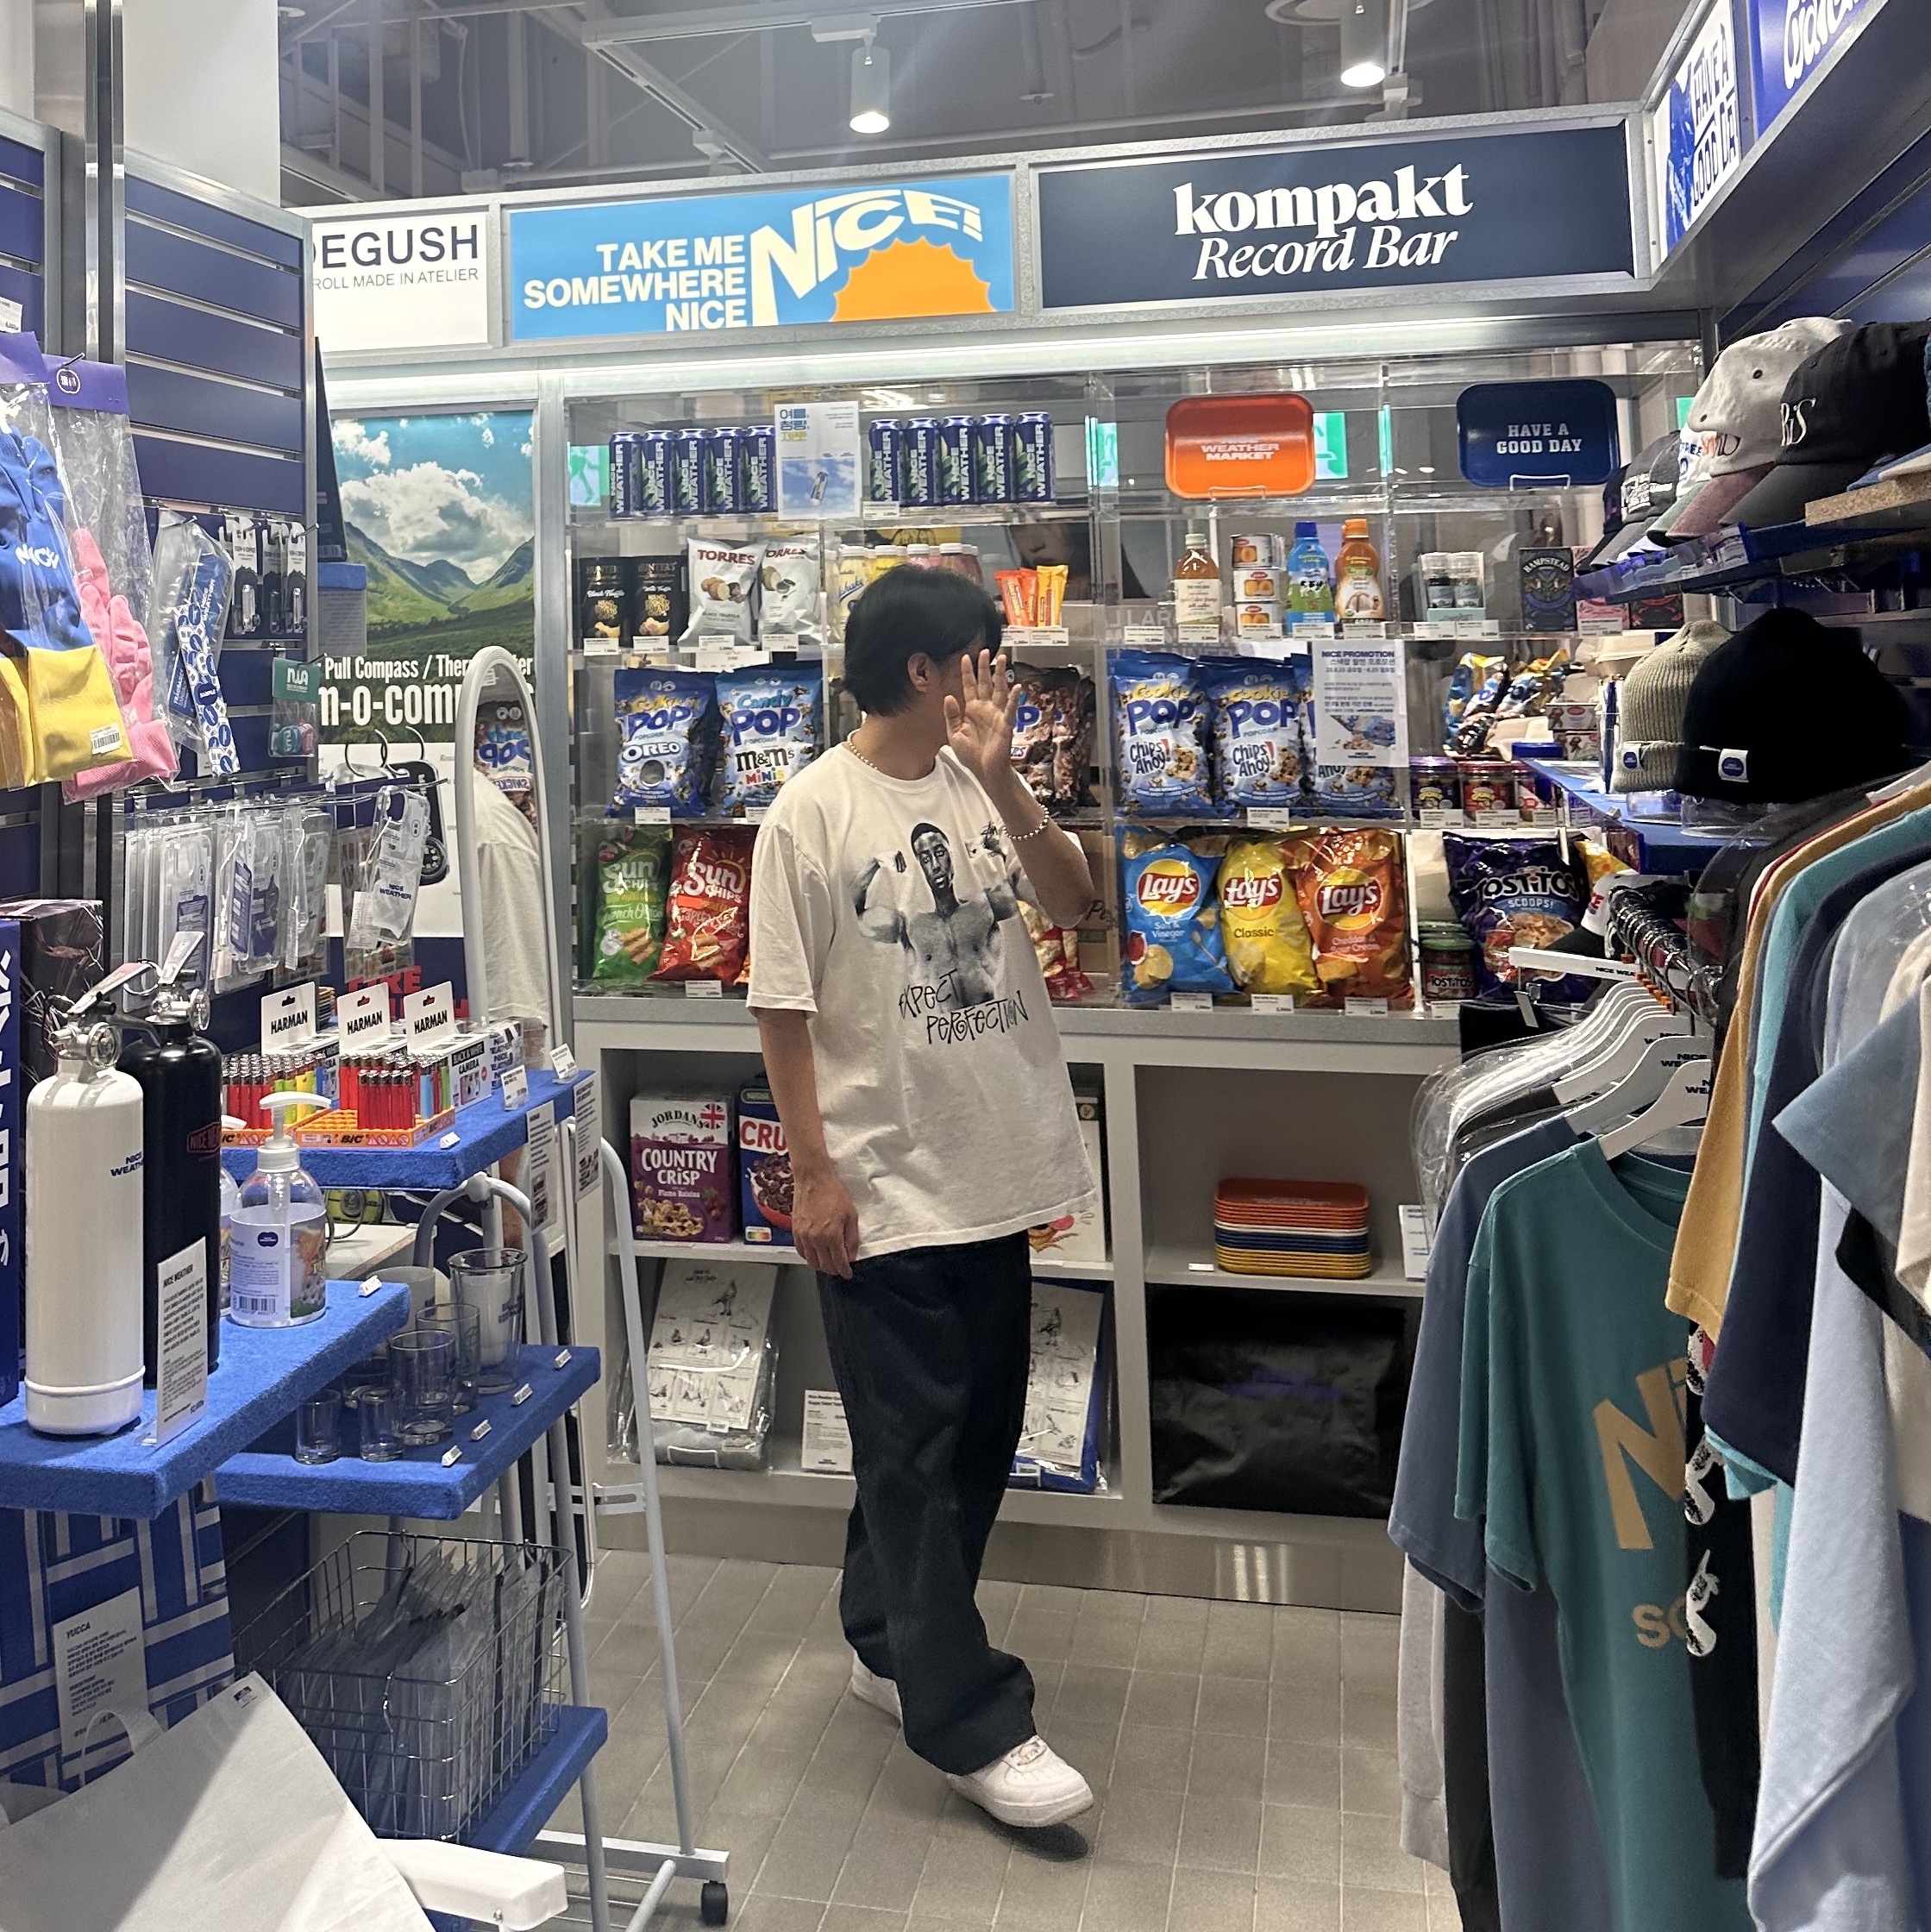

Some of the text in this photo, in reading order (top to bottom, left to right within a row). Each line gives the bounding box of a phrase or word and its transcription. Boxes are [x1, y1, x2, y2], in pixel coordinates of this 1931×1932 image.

[1173, 163, 1473, 239] kompakt
[313, 224, 478, 269] EGUSH
[596, 235, 746, 273] TAKE ME
[1192, 225, 1460, 282] Record Bar
[353, 273, 395, 289] MADE
[400, 271, 415, 285] IN
[417, 267, 479, 284] ATELIER
[524, 268, 746, 309] SOMEWHERE
[665, 299, 748, 332] NICE
[1508, 423, 1569, 437] HAVE A
[1201, 442, 1280, 453] WEATHER
[1205, 450, 1275, 461] MARKET
[1496, 438, 1583, 455] GOOD DAY
[758, 436, 768, 510] WEATHER
[917, 430, 928, 503] WEATHER
[959, 427, 970, 501] WEATHER
[994, 425, 1006, 500] WEATHER
[1035, 423, 1045, 499] WEATHER
[616, 443, 624, 515] WEATHER
[655, 442, 665, 512] WEATHER
[689, 440, 699, 512] WEATHER
[724, 438, 733, 511] WEATHER
[697, 549, 755, 566] TORRES
[1523, 557, 1570, 574] HAMPSTEAD
[324, 656, 351, 680] Pull
[354, 655, 419, 684] Compass
[737, 688, 793, 709] Candy
[1132, 681, 1190, 700] Cookie
[1229, 685, 1289, 701] Cookie
[627, 706, 692, 742] POP
[730, 707, 801, 746] POP
[1126, 699, 1195, 737] POP
[1226, 699, 1300, 739] POP
[621, 741, 681, 762] OREO
[1130, 741, 1163, 762] Chips
[1232, 743, 1268, 768] Chips
[683, 861, 744, 896] Sun
[1140, 874, 1197, 904] Lay's
[1226, 875, 1280, 907] Lay's
[704, 883, 743, 904] CHIPS
[1321, 885, 1378, 917] Lay's
[1508, 898, 1554, 908] SCOOPS!
[1152, 929, 1186, 939] Vinegar
[1233, 925, 1275, 938] Classic
[271, 1010, 308, 1035] HARMAN
[347, 1011, 383, 1035] HARMAN
[414, 1010, 448, 1034] HARMAN
[459, 1057, 480, 1075] CAMERA
[650, 1109, 706, 1129] JORDANS
[222, 1133, 235, 1143] IC
[341, 1134, 364, 1143] BIC
[641, 1148, 718, 1174] COUNTRY
[66, 1622, 91, 1640] YUCCA
